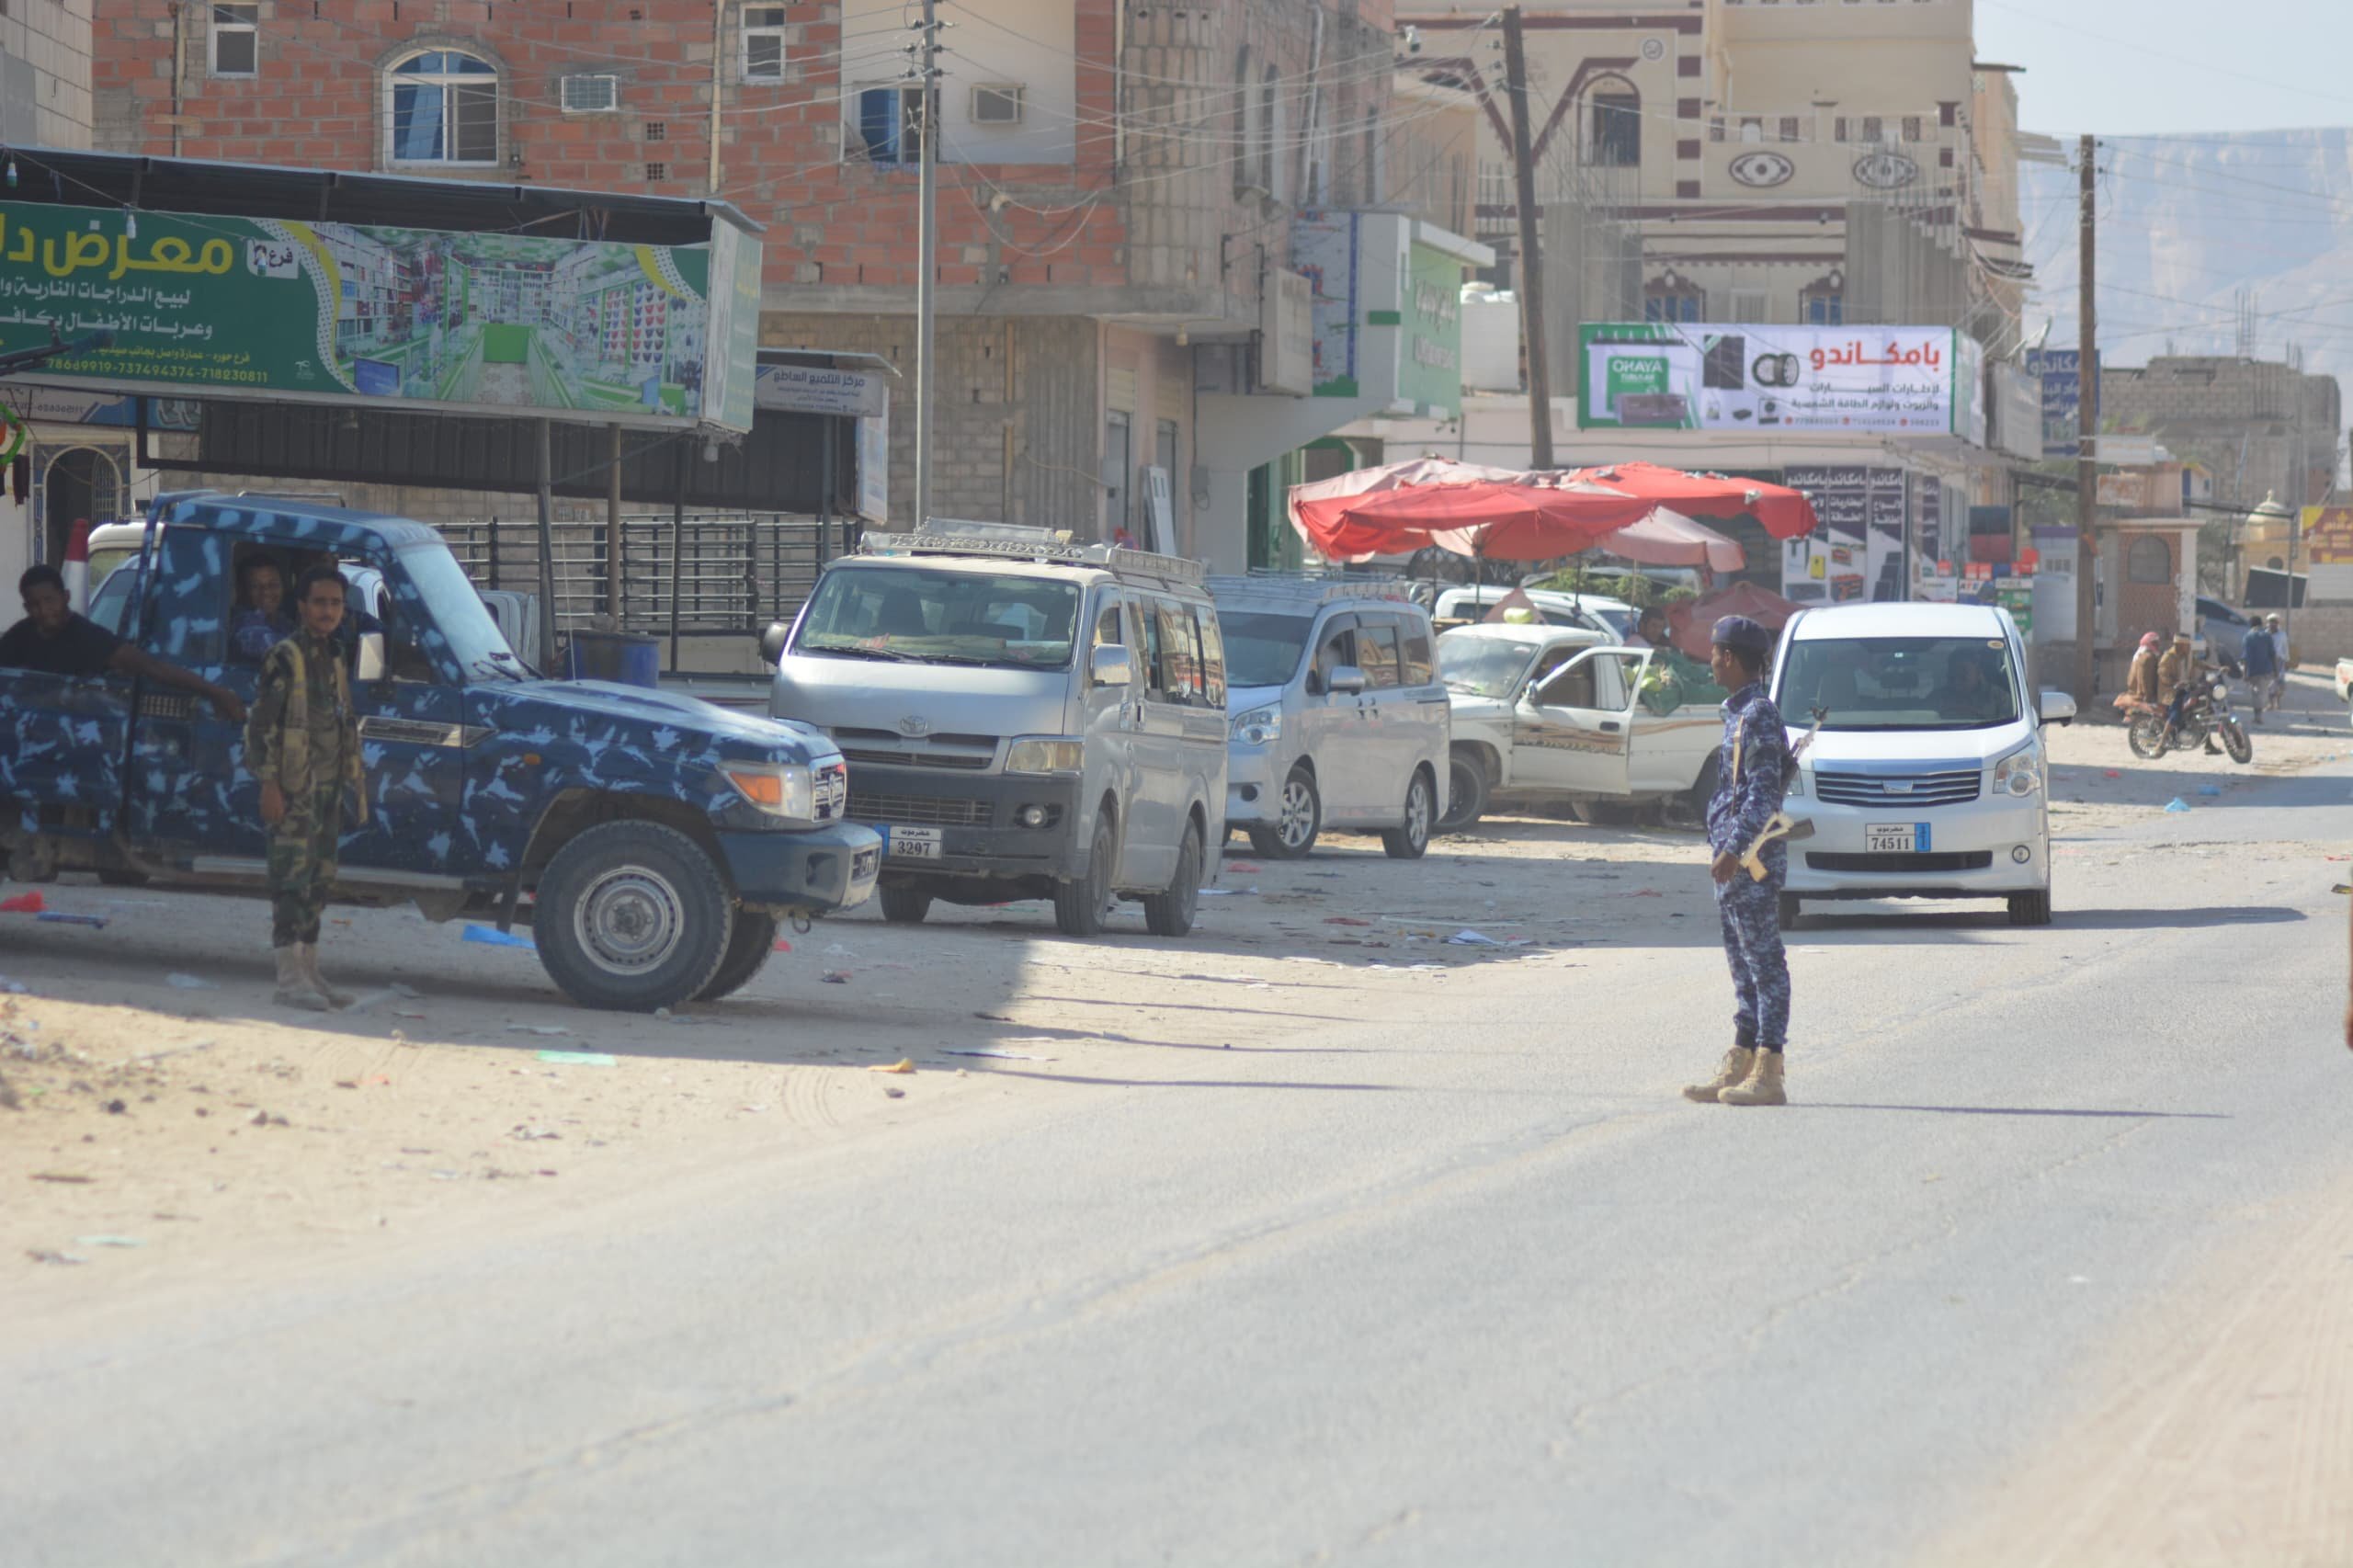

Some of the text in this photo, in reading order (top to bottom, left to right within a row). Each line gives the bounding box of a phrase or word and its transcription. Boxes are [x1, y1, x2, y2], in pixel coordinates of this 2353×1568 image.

[43, 219, 233, 279] معرض
[268, 246, 293, 267] فرع
[14, 277, 75, 301] النارية
[78, 283, 152, 304] الدراجات
[154, 289, 191, 309] لبيع
[65, 311, 137, 333] الأطفال
[140, 315, 213, 340] وعربات
[1809, 340, 1940, 371] بامكاندو
[897, 840, 931, 857] 3297
[1871, 836, 1909, 851] 74511
